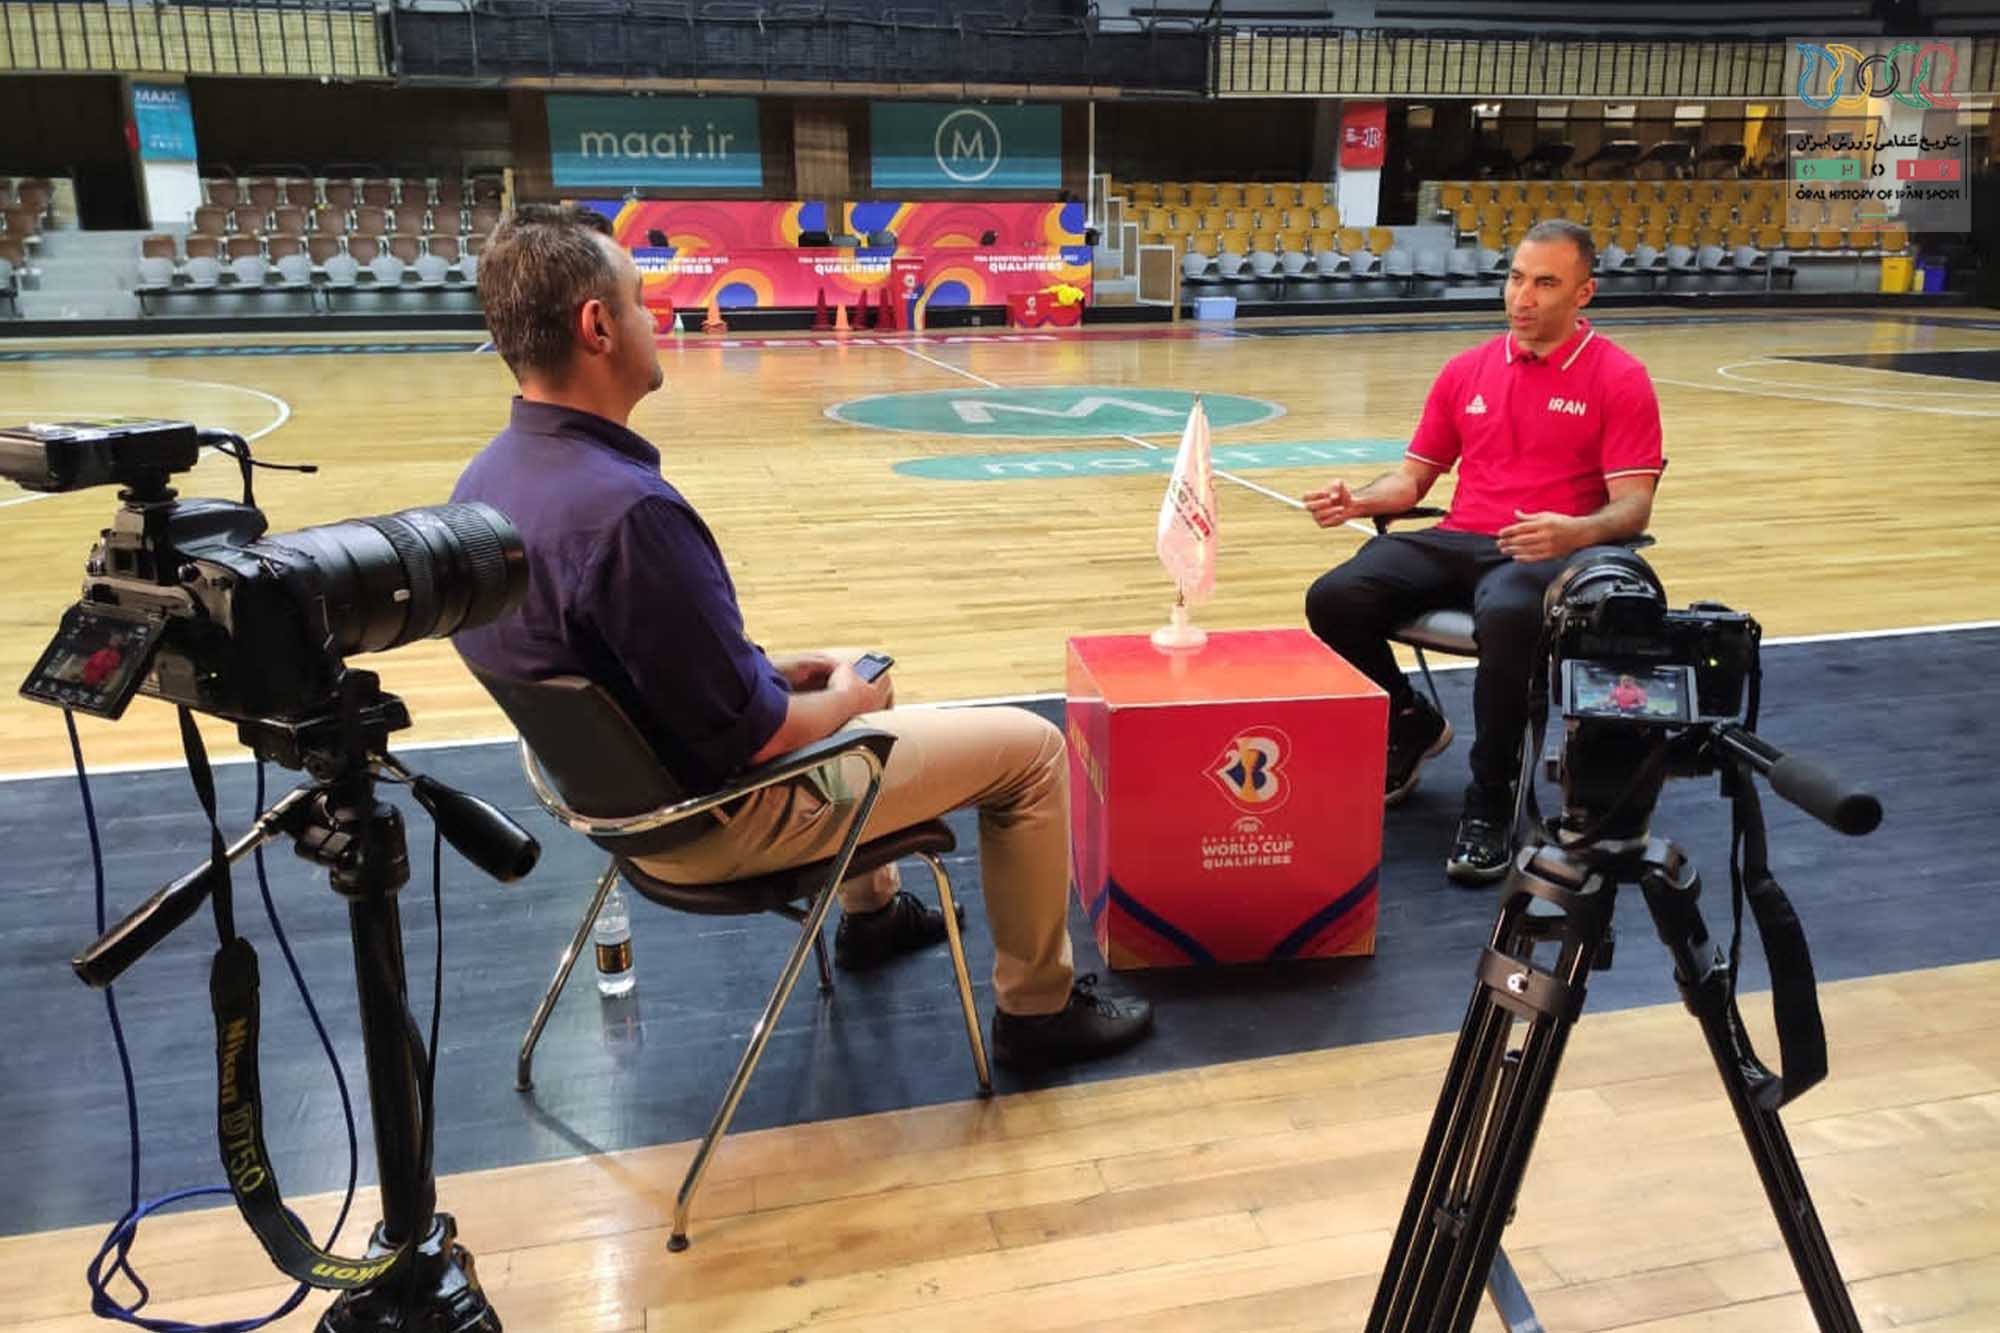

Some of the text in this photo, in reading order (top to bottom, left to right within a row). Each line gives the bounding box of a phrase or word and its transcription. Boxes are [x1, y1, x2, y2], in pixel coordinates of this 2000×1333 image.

[579, 123, 735, 160] maat.ir
[951, 129, 986, 163] M
[988, 262, 1063, 274] QUALIFIERS
[1547, 397, 1587, 416] IRAN
[1202, 840, 1295, 856] WORLD CUP
[1202, 855, 1292, 870] QUALIFIERS
